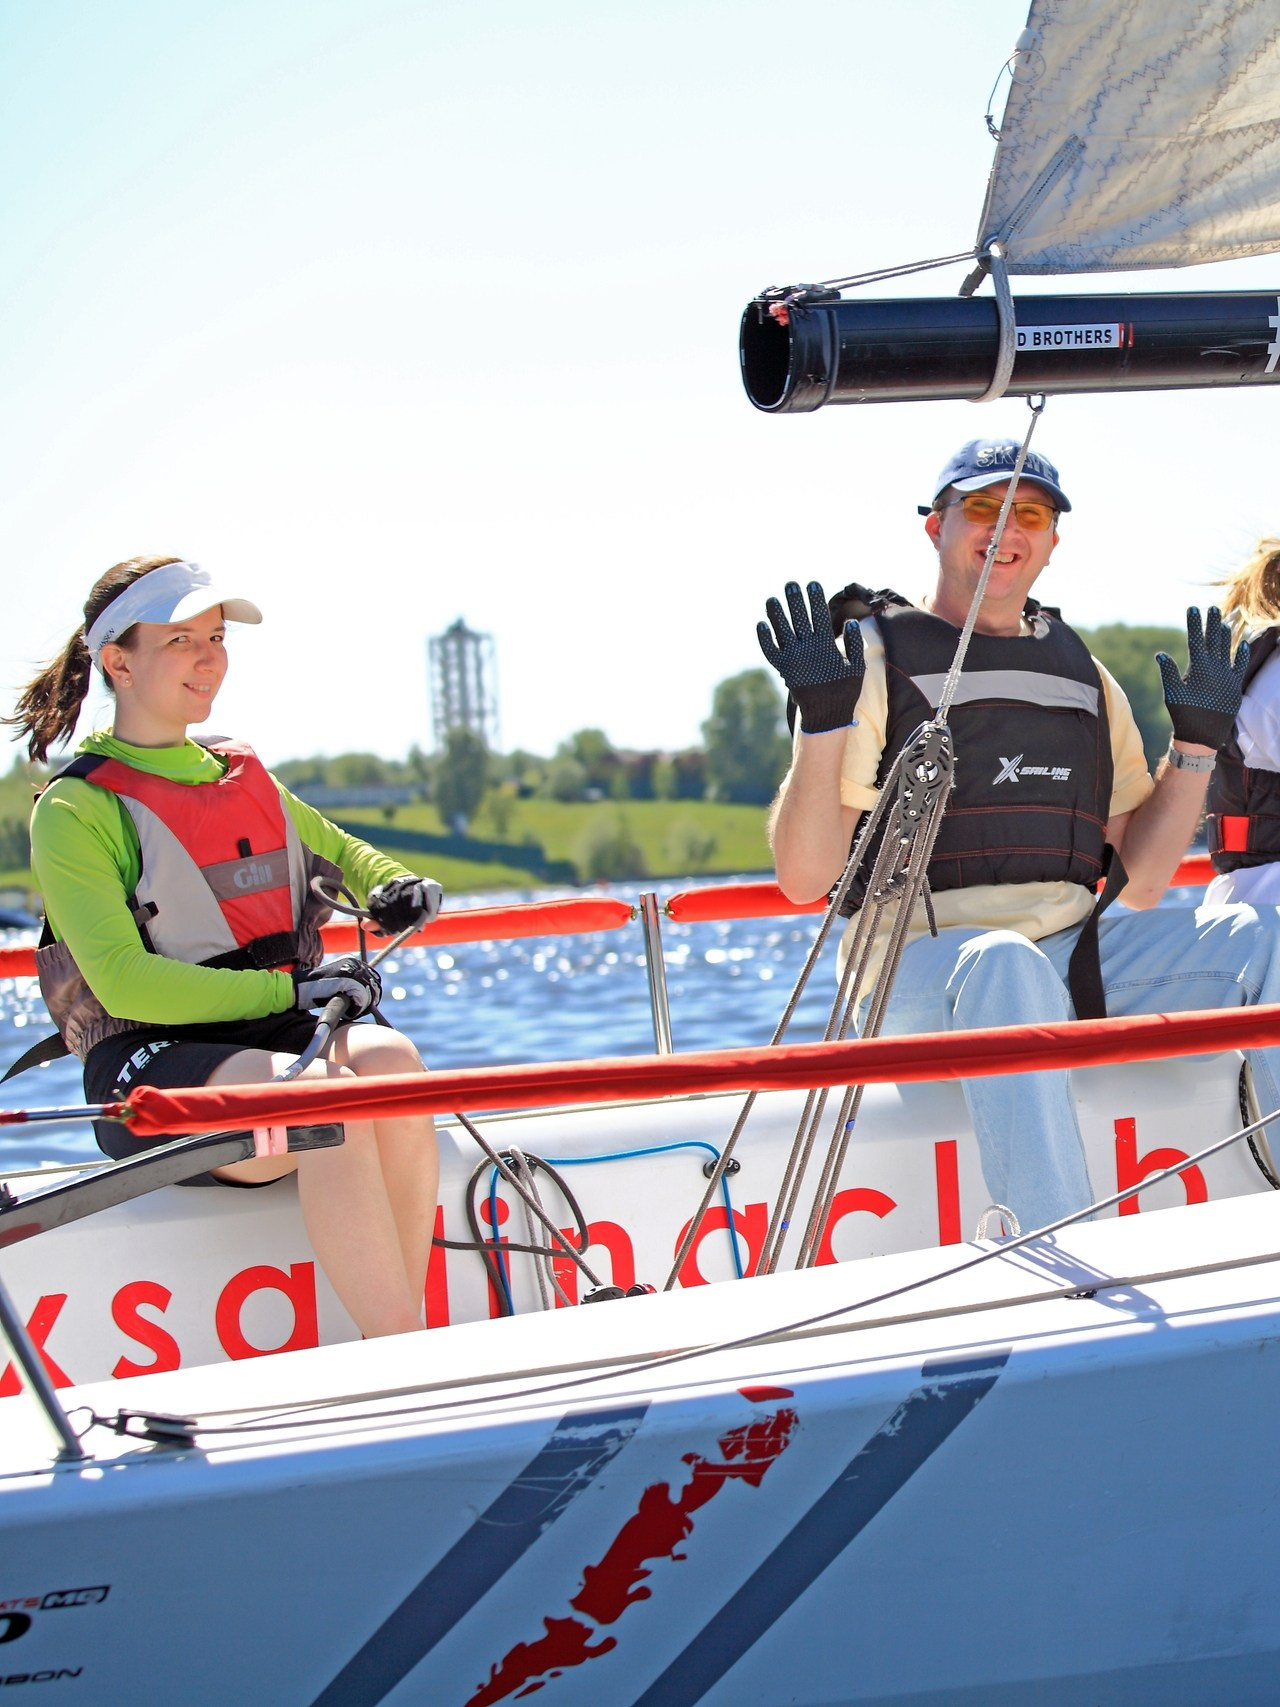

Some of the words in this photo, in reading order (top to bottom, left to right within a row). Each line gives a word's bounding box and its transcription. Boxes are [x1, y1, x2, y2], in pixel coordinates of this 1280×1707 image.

[1033, 329, 1112, 346] BROTHERS
[233, 863, 273, 889] Gill
[117, 1040, 179, 1083] TER
[0, 1666, 84, 1686] BON
